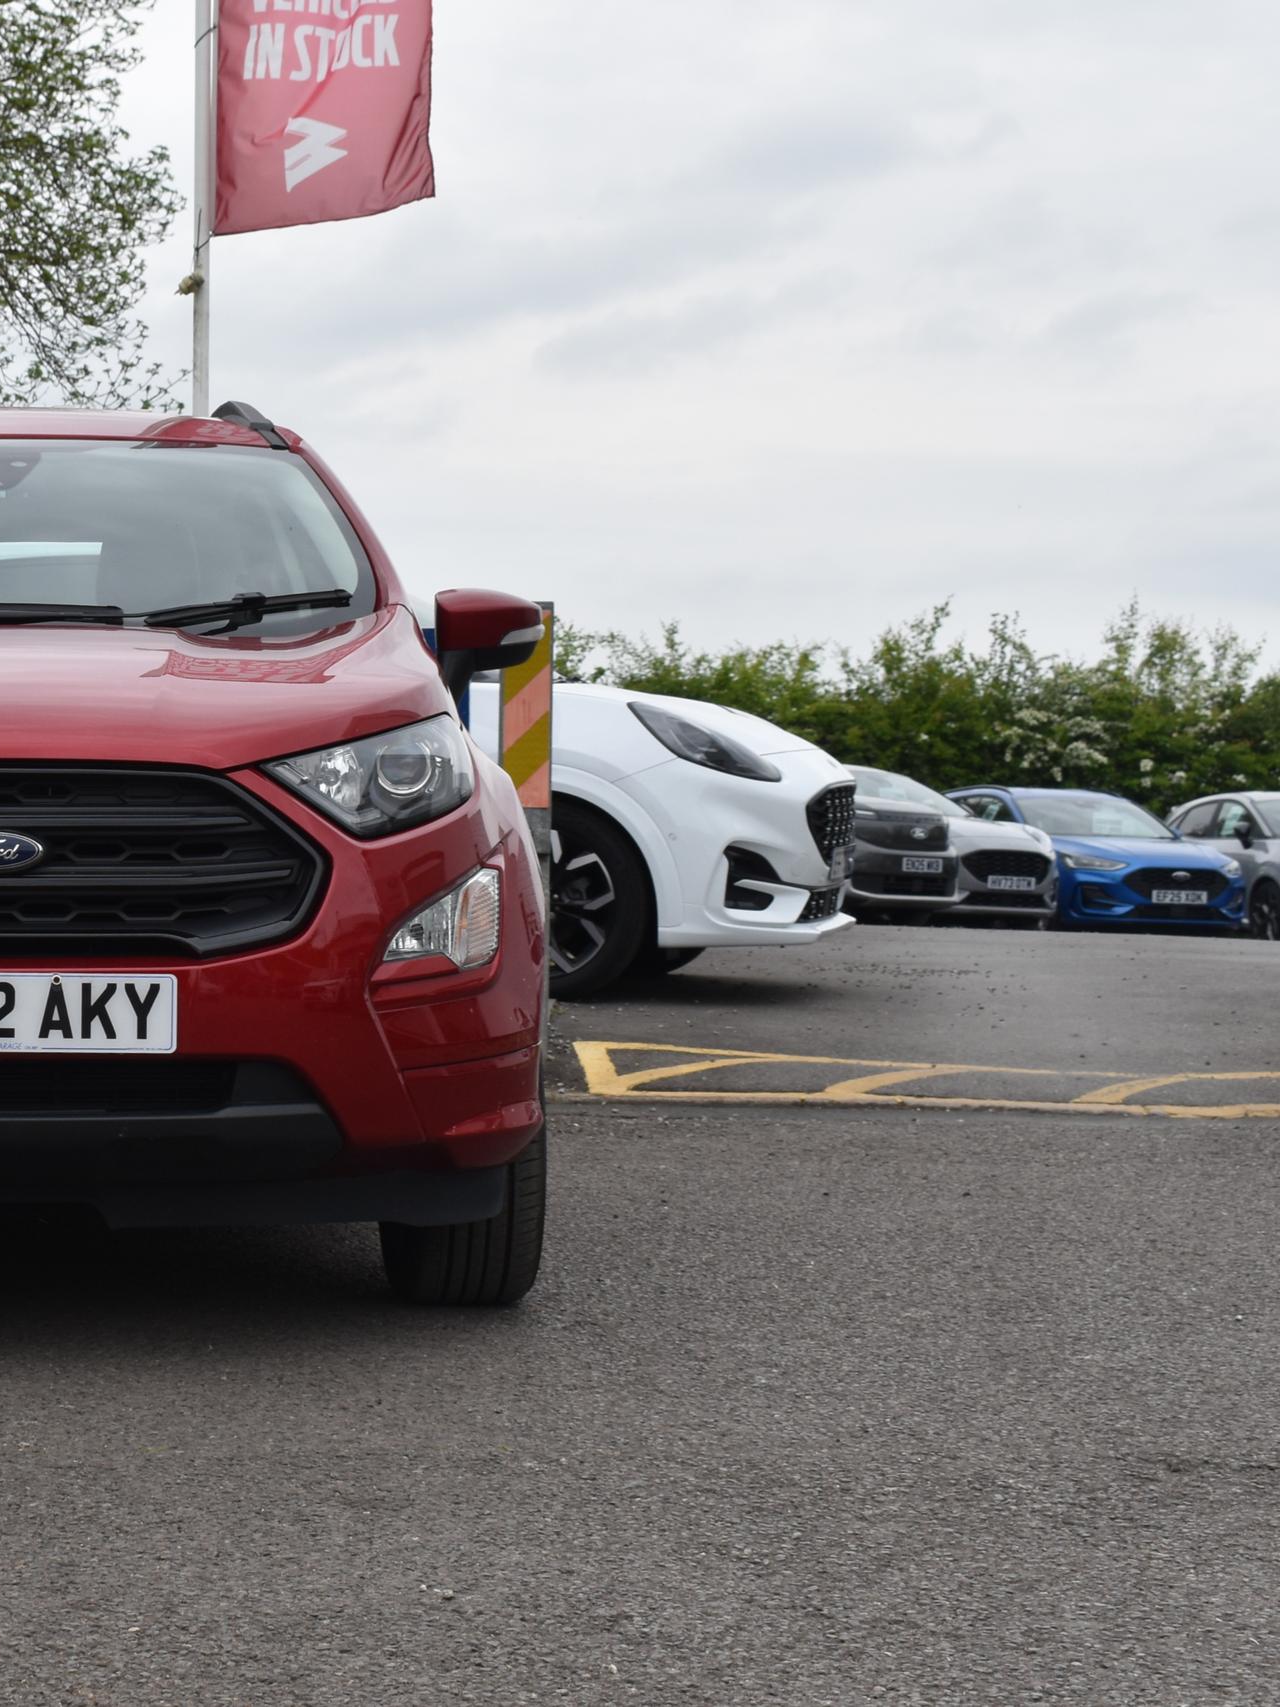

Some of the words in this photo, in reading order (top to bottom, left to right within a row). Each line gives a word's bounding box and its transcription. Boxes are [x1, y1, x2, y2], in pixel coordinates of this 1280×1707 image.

[243, 23, 286, 81] IN
[289, 14, 401, 83] STOCK
[38, 982, 161, 1040] AKY
